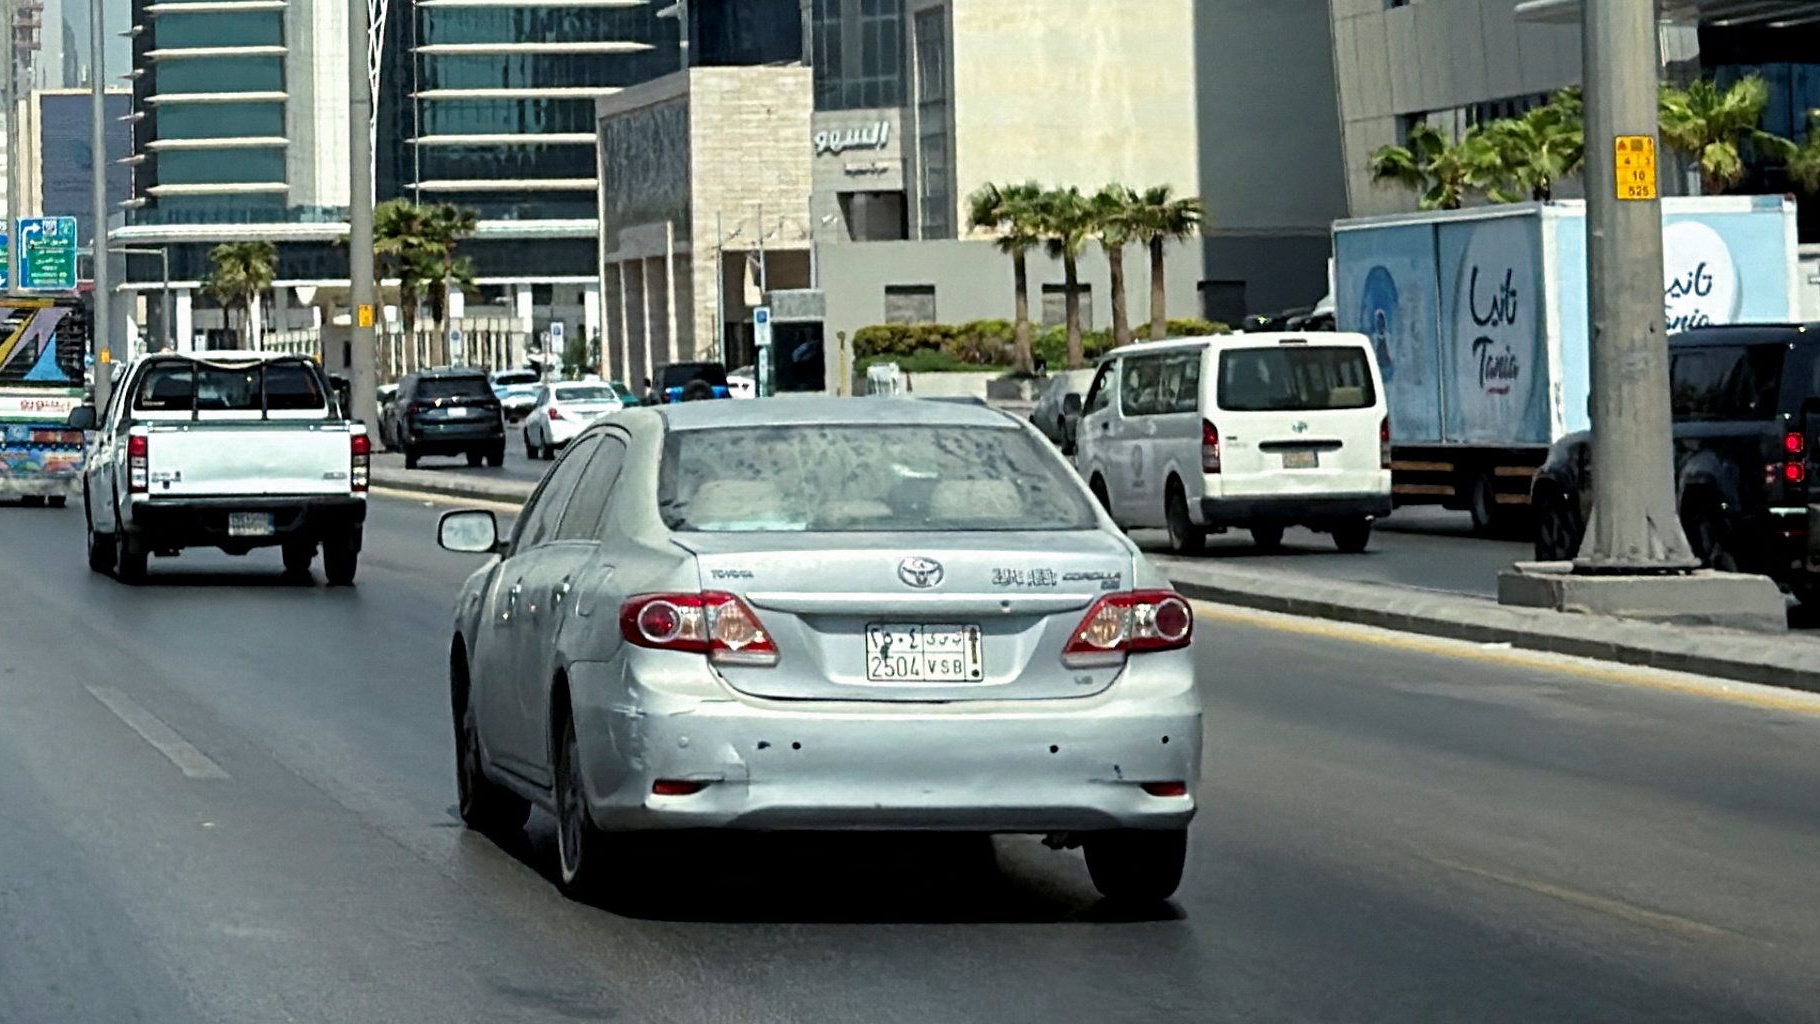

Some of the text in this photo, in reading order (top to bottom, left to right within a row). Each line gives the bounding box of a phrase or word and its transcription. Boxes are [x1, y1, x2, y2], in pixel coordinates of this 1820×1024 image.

[1632, 170, 1646, 181] 10
[1470, 265, 1517, 327] تانيا
[1665, 262, 1713, 298] تاني
[1471, 336, 1520, 389] Tania
[871, 656, 920, 678] 2504
